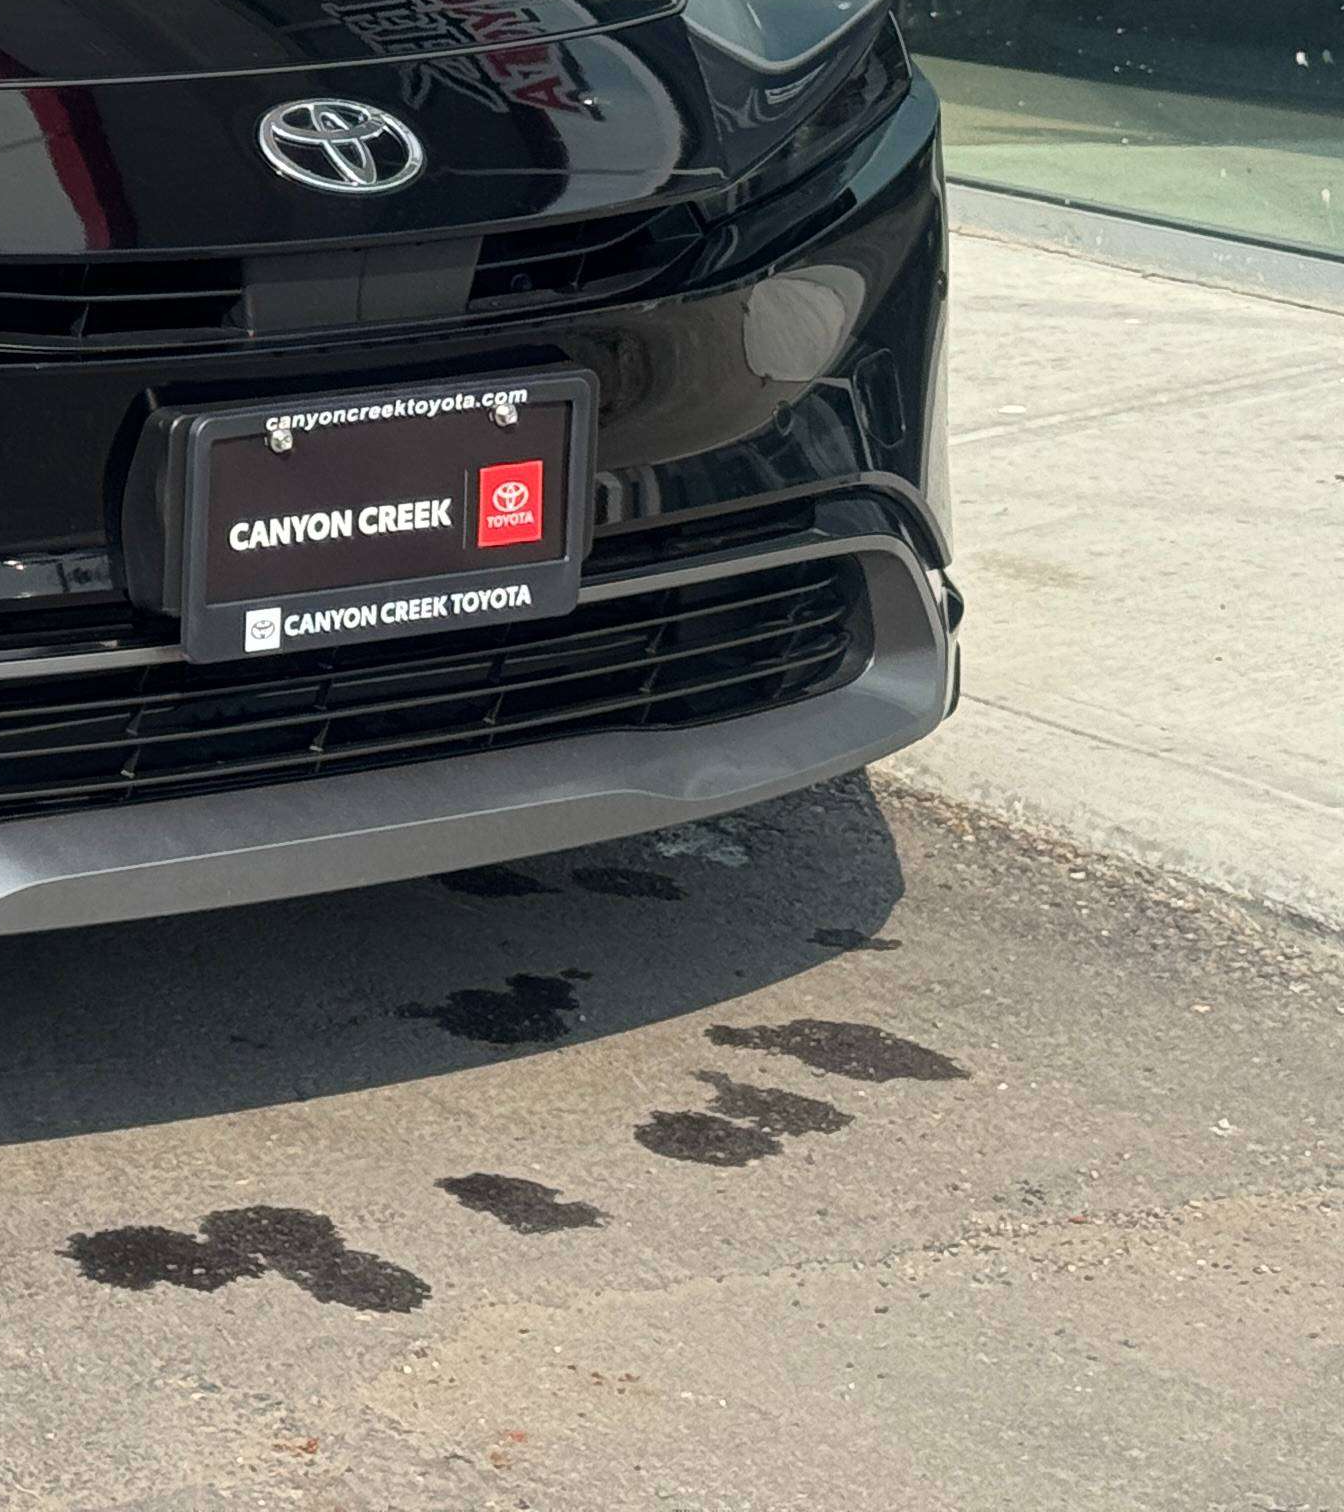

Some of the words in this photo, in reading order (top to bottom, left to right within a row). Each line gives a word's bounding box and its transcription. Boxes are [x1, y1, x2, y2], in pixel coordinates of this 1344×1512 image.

[265, 389, 528, 431] canyoncreektoyota.com
[229, 510, 353, 552] CANYON
[358, 498, 452, 535] CREEK
[487, 511, 535, 529] TOYOTA
[284, 603, 378, 637] CANYON
[381, 595, 448, 623] CREEK
[452, 584, 532, 615] TOYOTA
